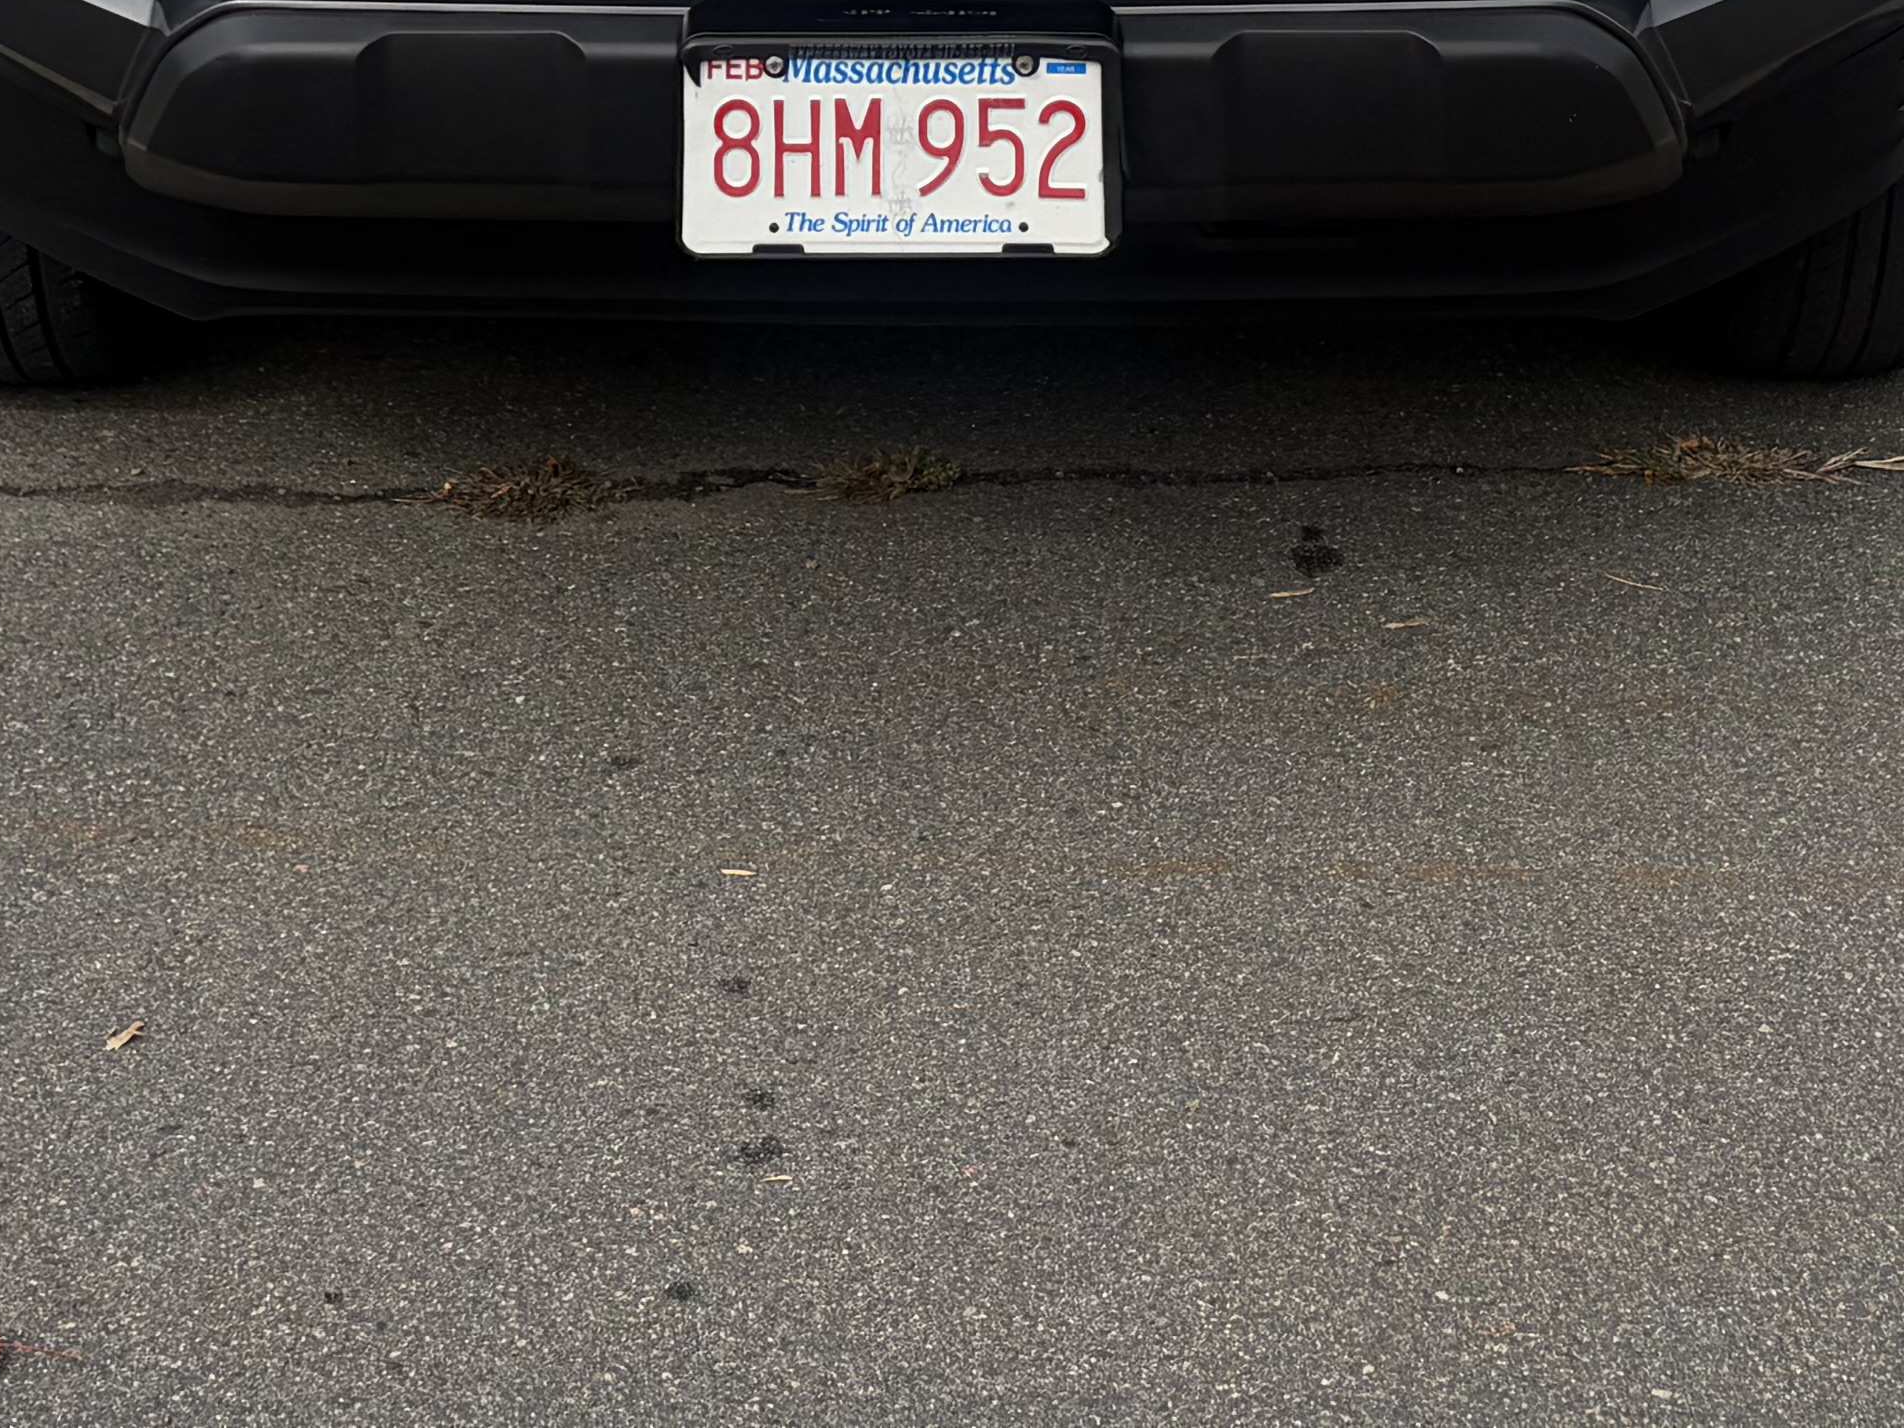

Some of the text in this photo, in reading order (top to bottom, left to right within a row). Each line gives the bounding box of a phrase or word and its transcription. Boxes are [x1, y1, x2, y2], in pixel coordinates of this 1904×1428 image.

[707, 56, 1016, 85] FEB Massachusetts
[713, 97, 1087, 200] 8HM 952
[785, 211, 1012, 237] The Spirit of America
